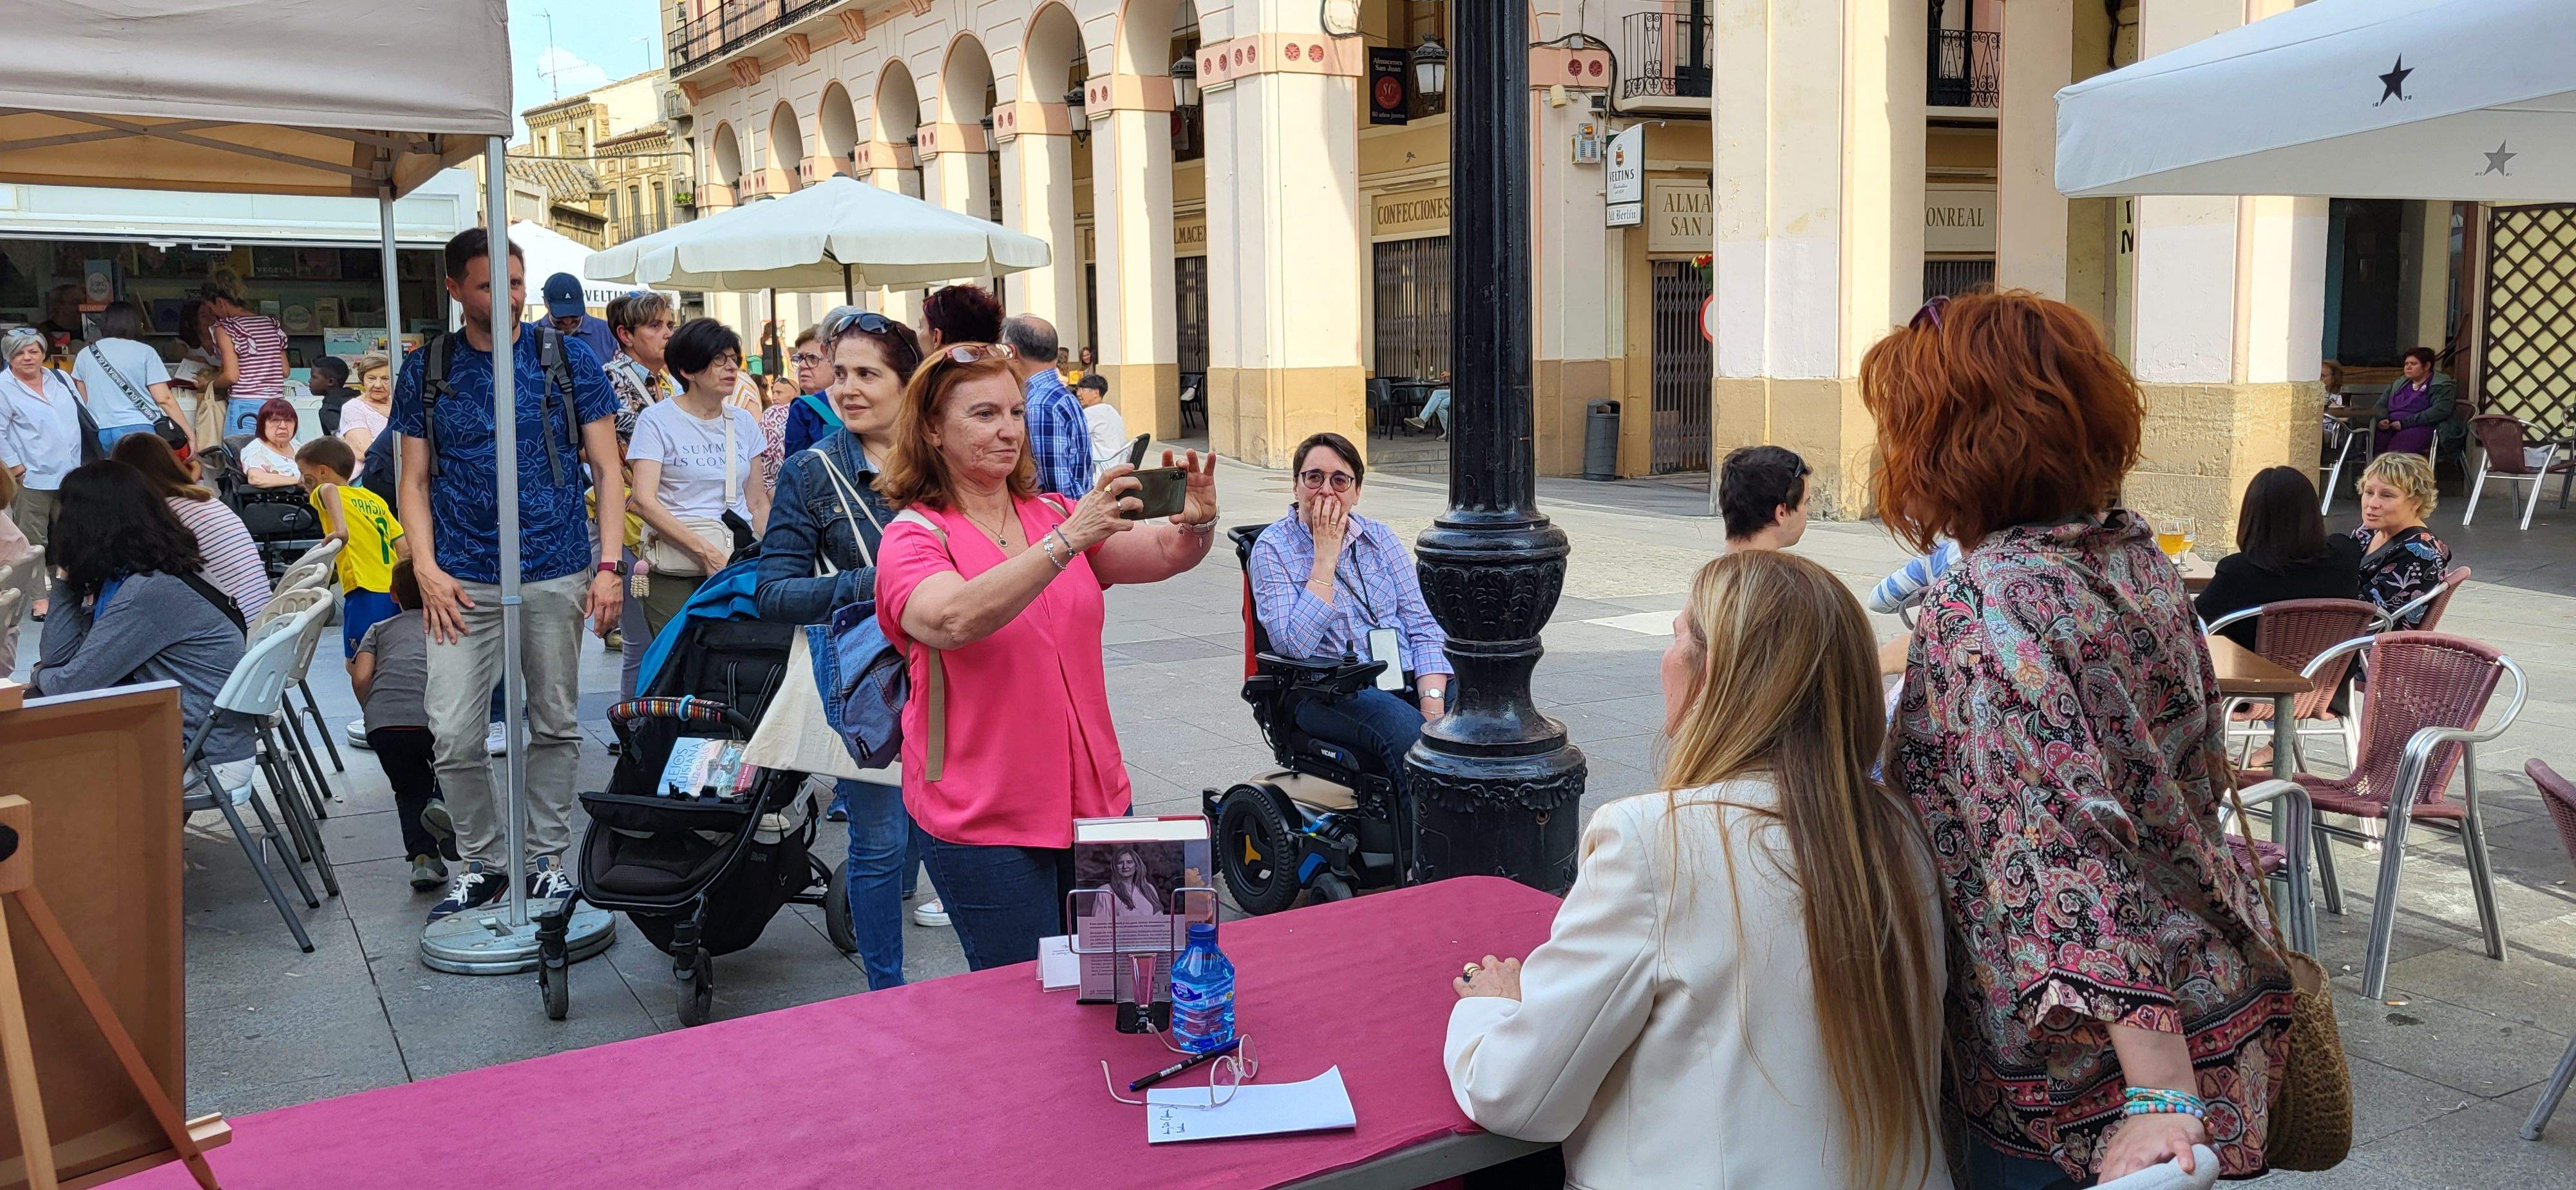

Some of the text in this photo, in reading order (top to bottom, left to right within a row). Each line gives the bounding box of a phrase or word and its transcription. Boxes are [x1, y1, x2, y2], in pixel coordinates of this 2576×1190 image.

[1373, 57, 1403, 66] Almacenes
[1609, 169, 1634, 182] VELTINS
[1378, 197, 1449, 225] CONFECCIONES
[1616, 209, 1636, 220] Berlin
[1926, 207, 1985, 227] ONREAL
[1670, 216, 1701, 236] SAN
[683, 440, 743, 455] SUMMR
[666, 748, 688, 782] LEJOS
[677, 742, 703, 789] LUISIANA
